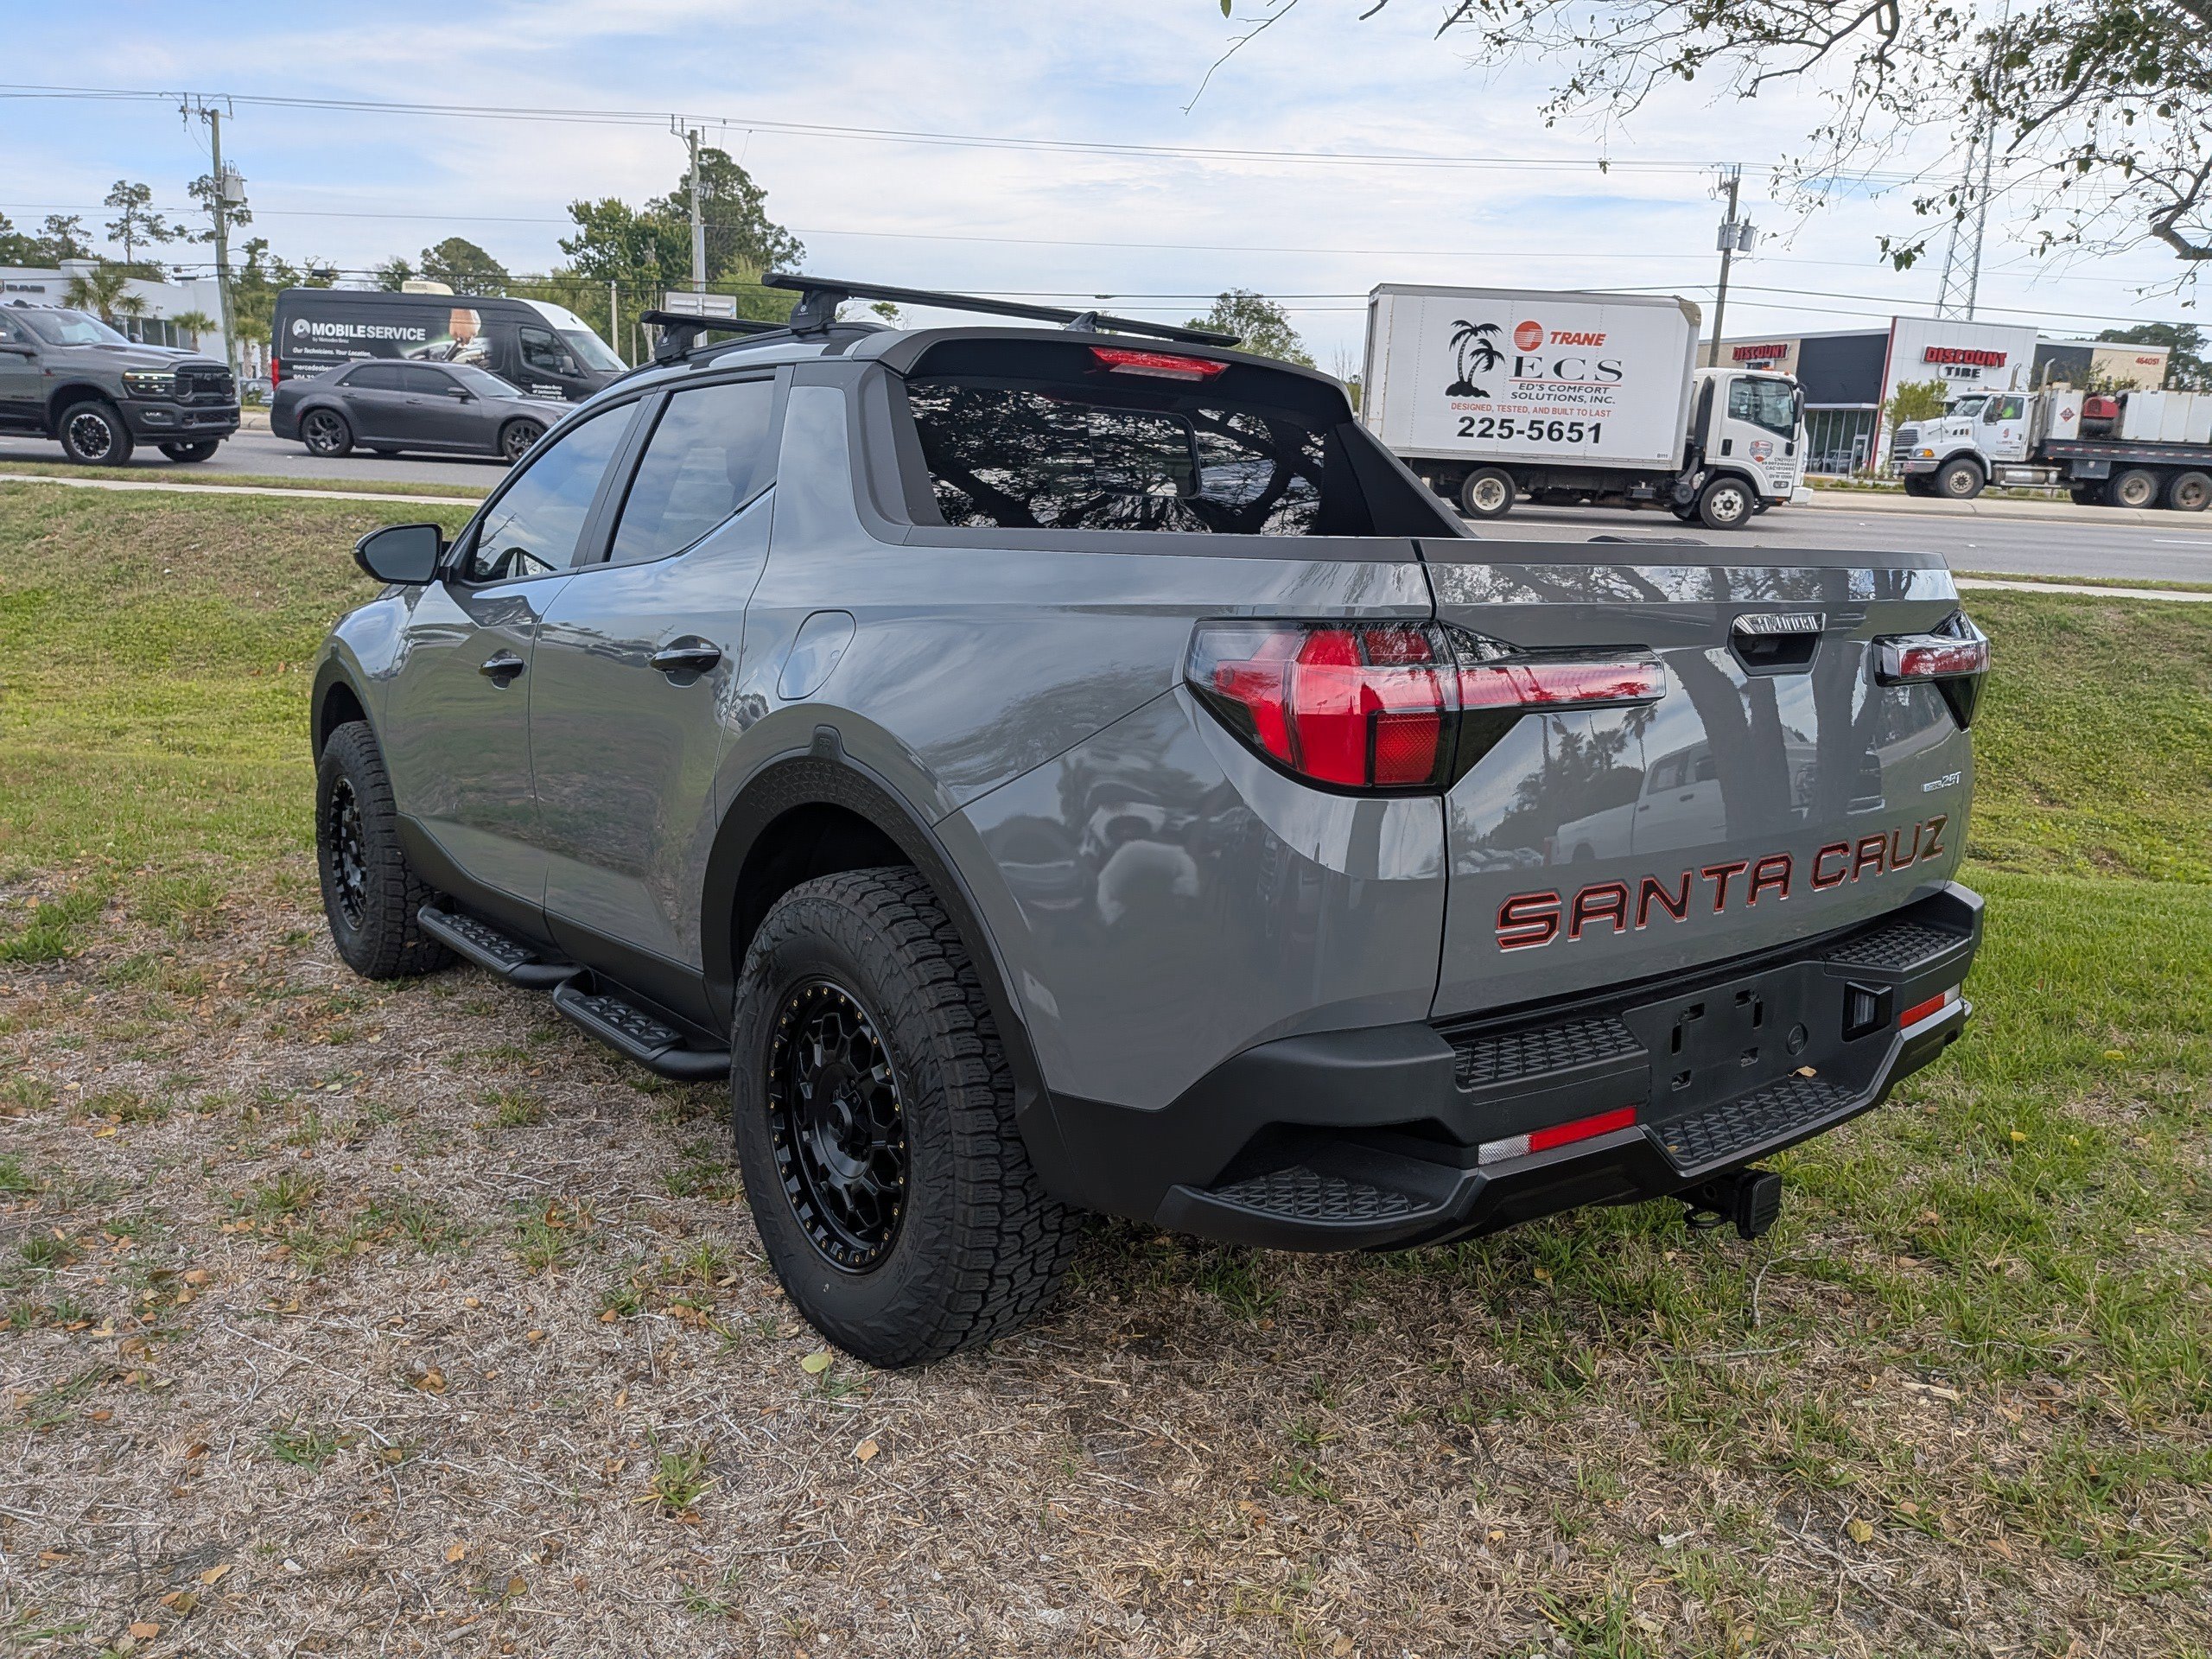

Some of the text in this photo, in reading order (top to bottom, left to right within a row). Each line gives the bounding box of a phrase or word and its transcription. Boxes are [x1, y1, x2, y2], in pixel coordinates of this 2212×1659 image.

[311, 322, 426, 341] MOBILESERVICE
[1549, 331, 1606, 346] TRANE
[1732, 344, 1788, 360] DISCOUNT
[1923, 346, 2007, 368] DISCOUNT
[1511, 355, 1623, 383] ECS
[1945, 366, 1981, 378] TIRE
[1518, 383, 1611, 395] ED'S COMFORT
[1510, 391, 1616, 404] SOLUTIONS, INC.
[1451, 403, 1494, 412] DESIGNED,
[1497, 404, 1530, 414] TESTED,
[1457, 416, 1602, 444] 225-5651
[1496, 814, 1948, 952] SANTA CRUZ
